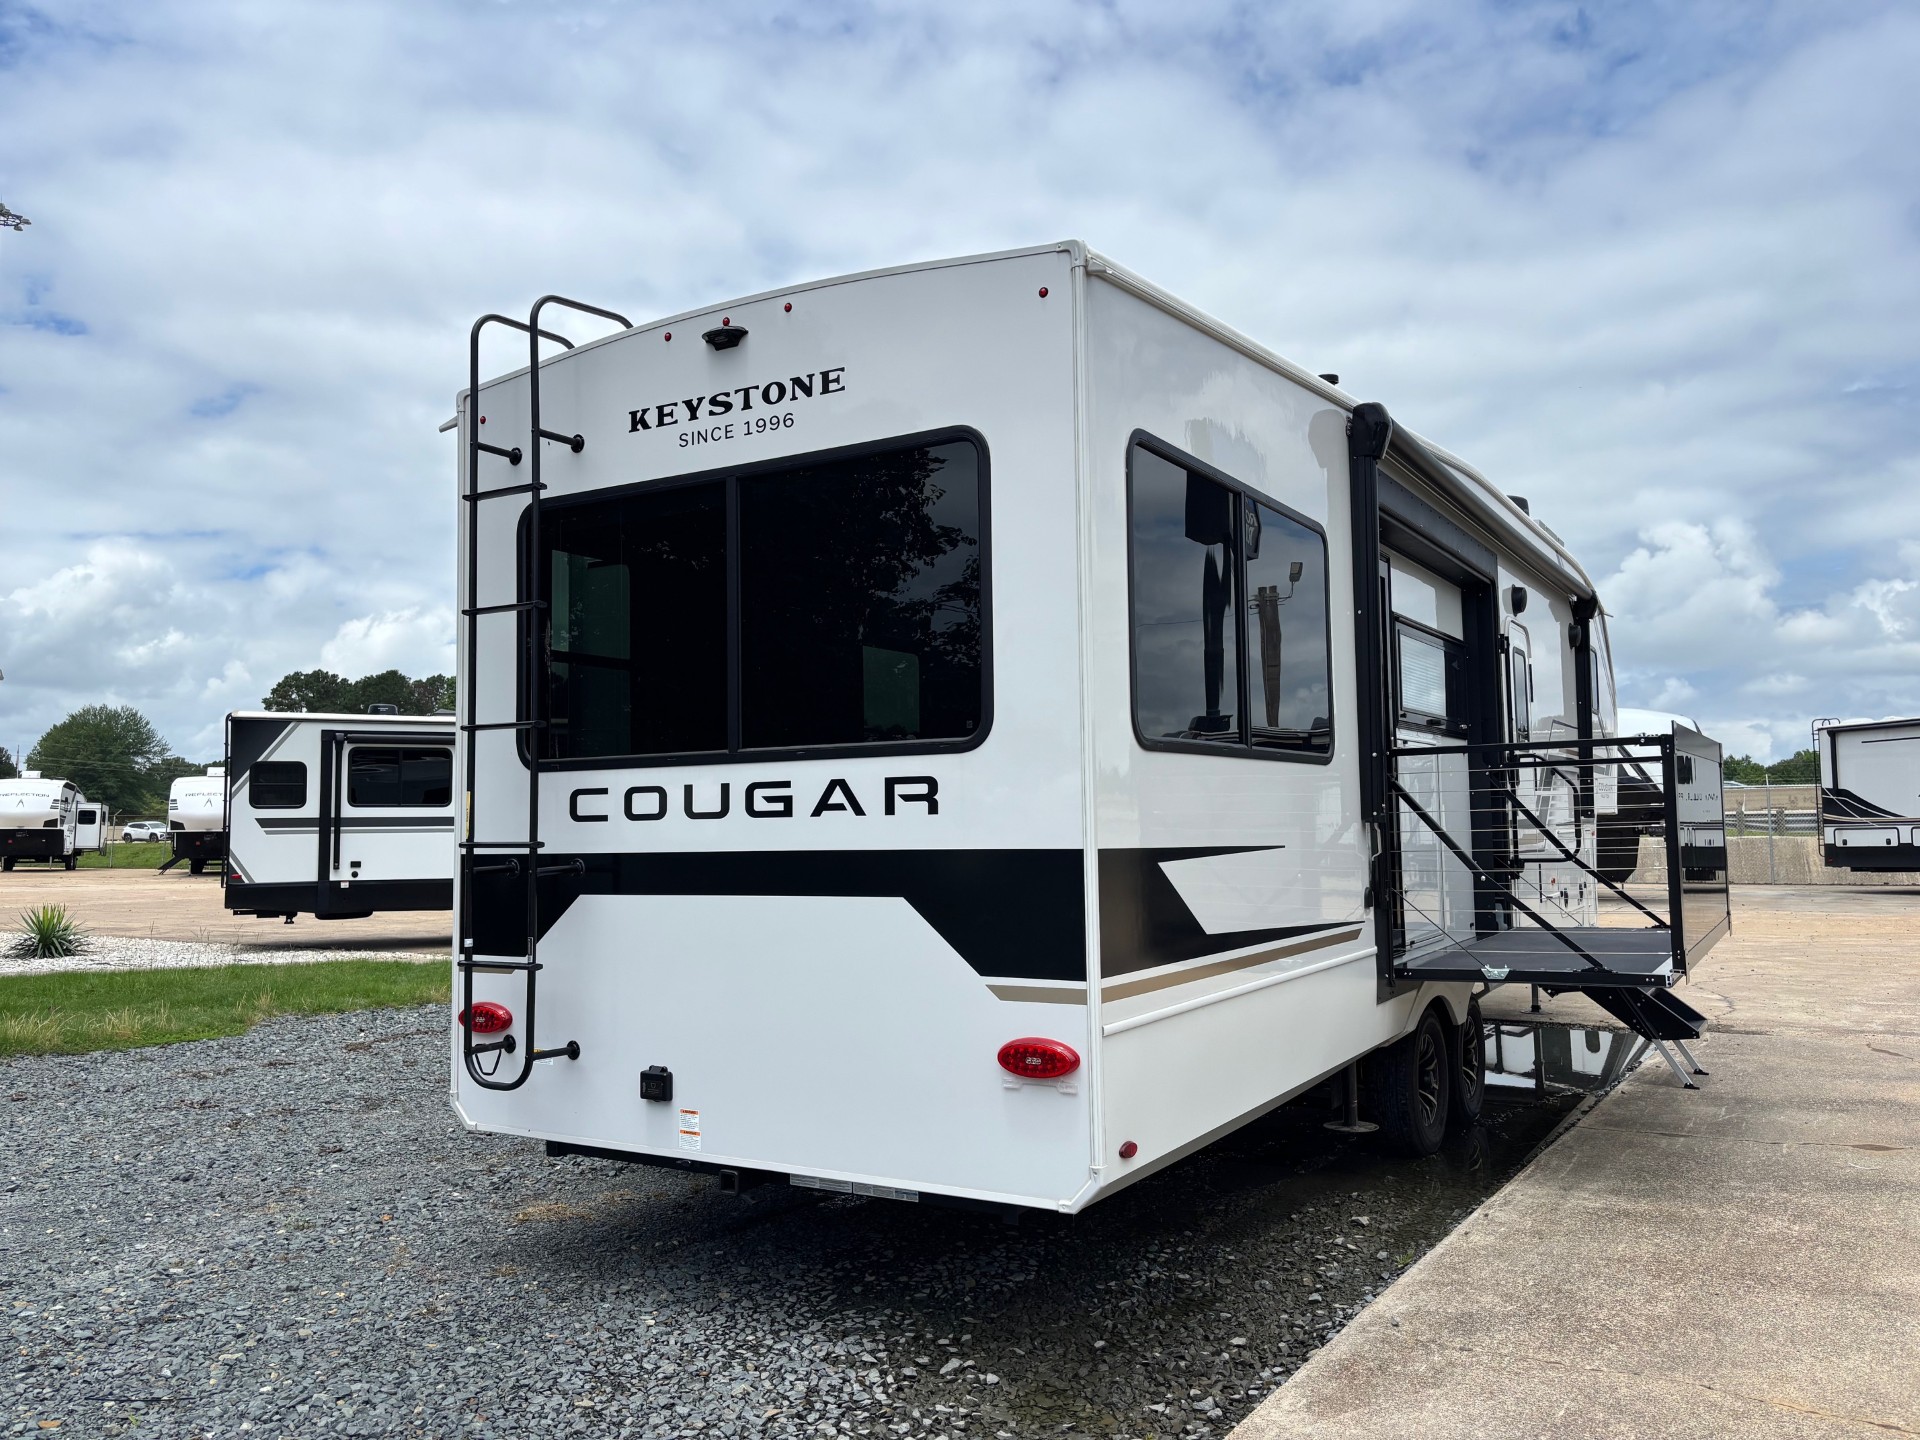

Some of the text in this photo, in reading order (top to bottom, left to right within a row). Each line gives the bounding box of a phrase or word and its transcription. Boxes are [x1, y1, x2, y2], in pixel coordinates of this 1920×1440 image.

[629, 367, 845, 433] KEYSTONE
[679, 412, 795, 447] SINCE 1996
[569, 775, 939, 823] COUGAR
